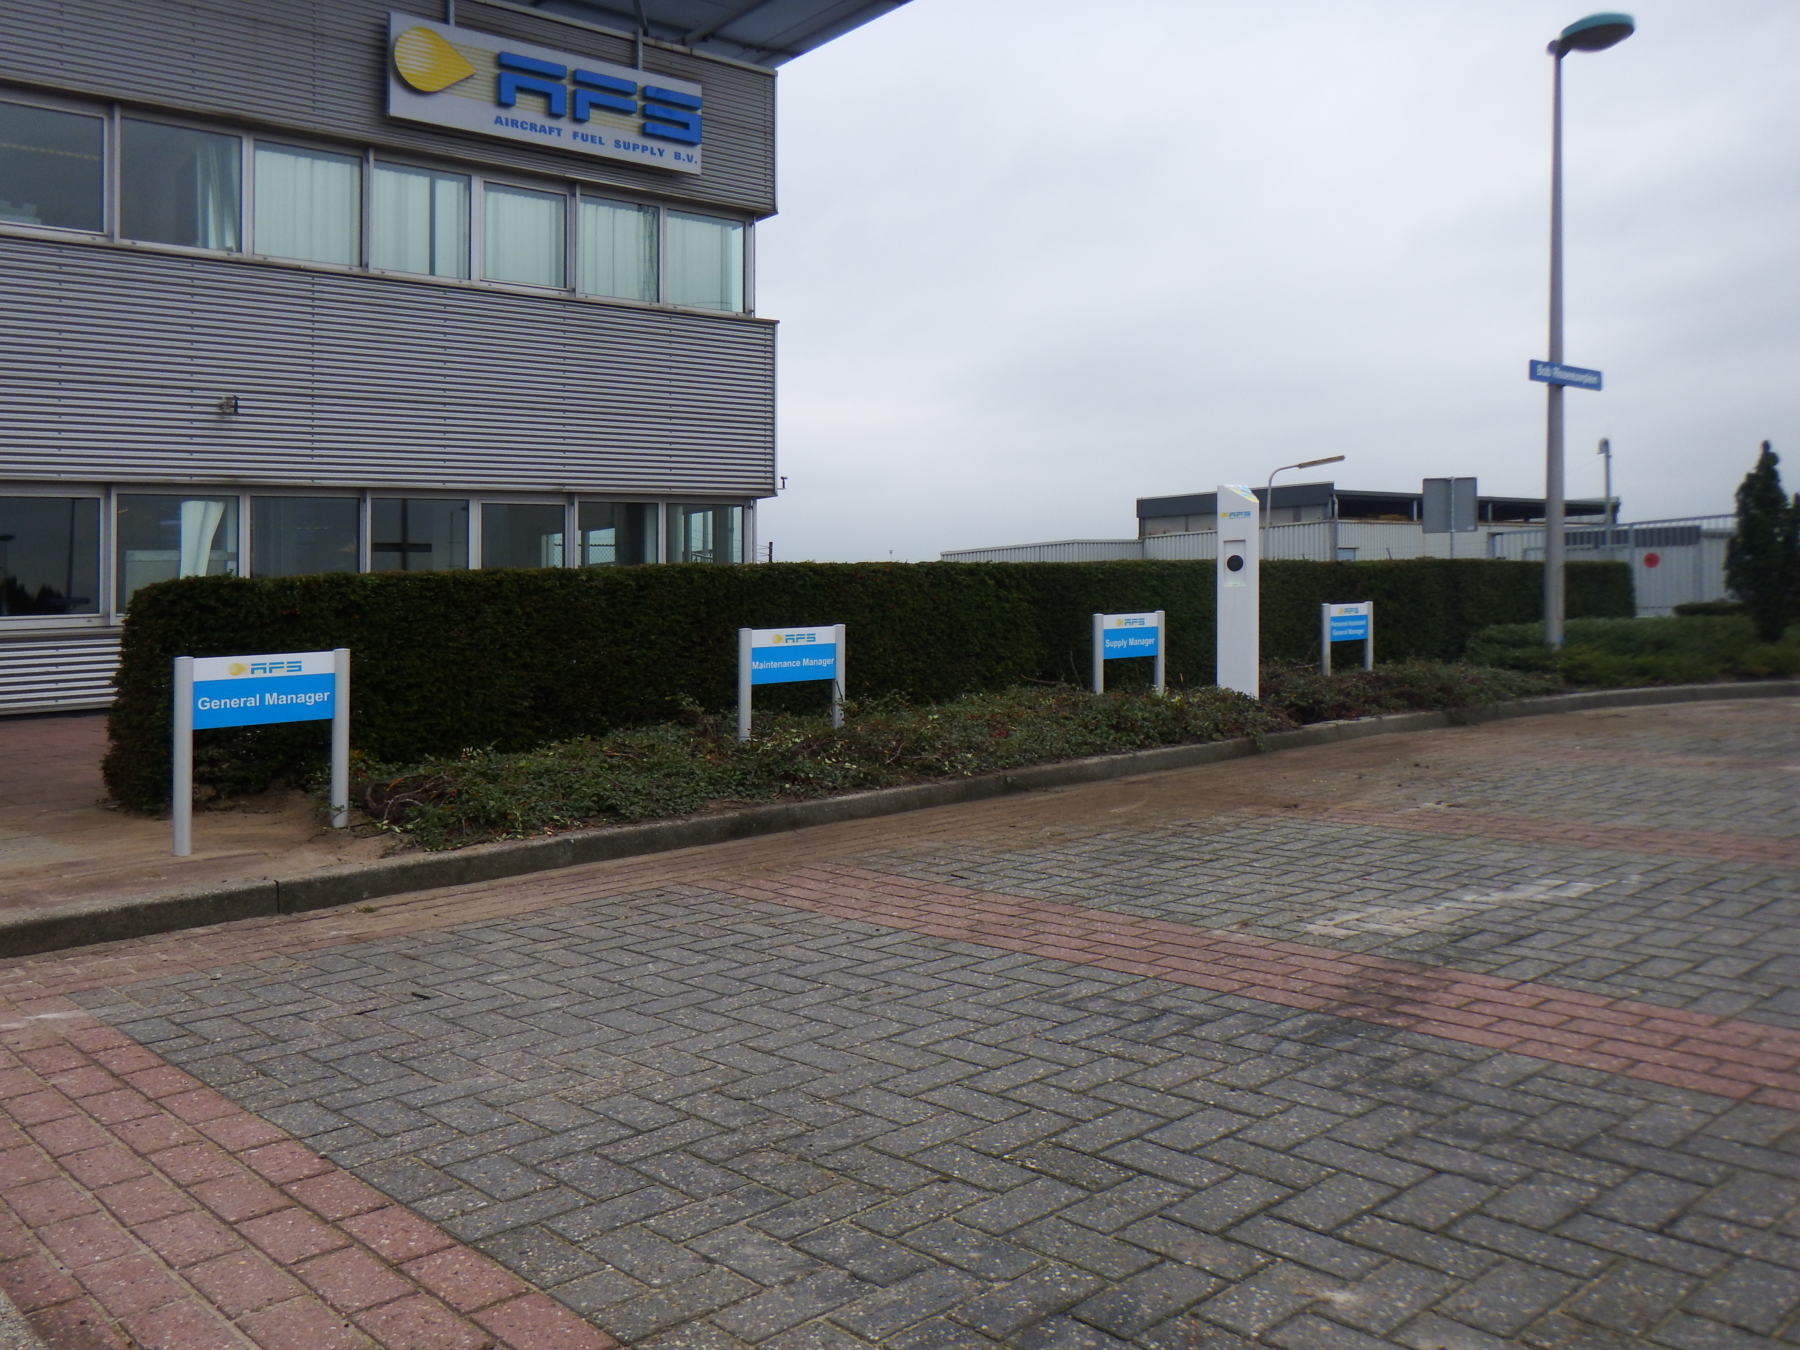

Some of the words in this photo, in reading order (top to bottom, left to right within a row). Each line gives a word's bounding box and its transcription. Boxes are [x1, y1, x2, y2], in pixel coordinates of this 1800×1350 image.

[498, 51, 702, 146] AFS
[494, 115, 563, 138] AIRCRAFT
[572, 131, 605, 146] FUEL
[613, 139, 665, 158] SUPPLY
[674, 151, 698, 164] B.V.
[785, 633, 816, 643] AFS
[1105, 639, 1128, 648] Supply
[1129, 638, 1155, 646] Manager
[251, 661, 302, 674] AFS
[752, 660, 800, 670] Maintenance
[803, 658, 834, 666] Manager
[198, 694, 260, 710] General
[265, 691, 330, 705] Manager
